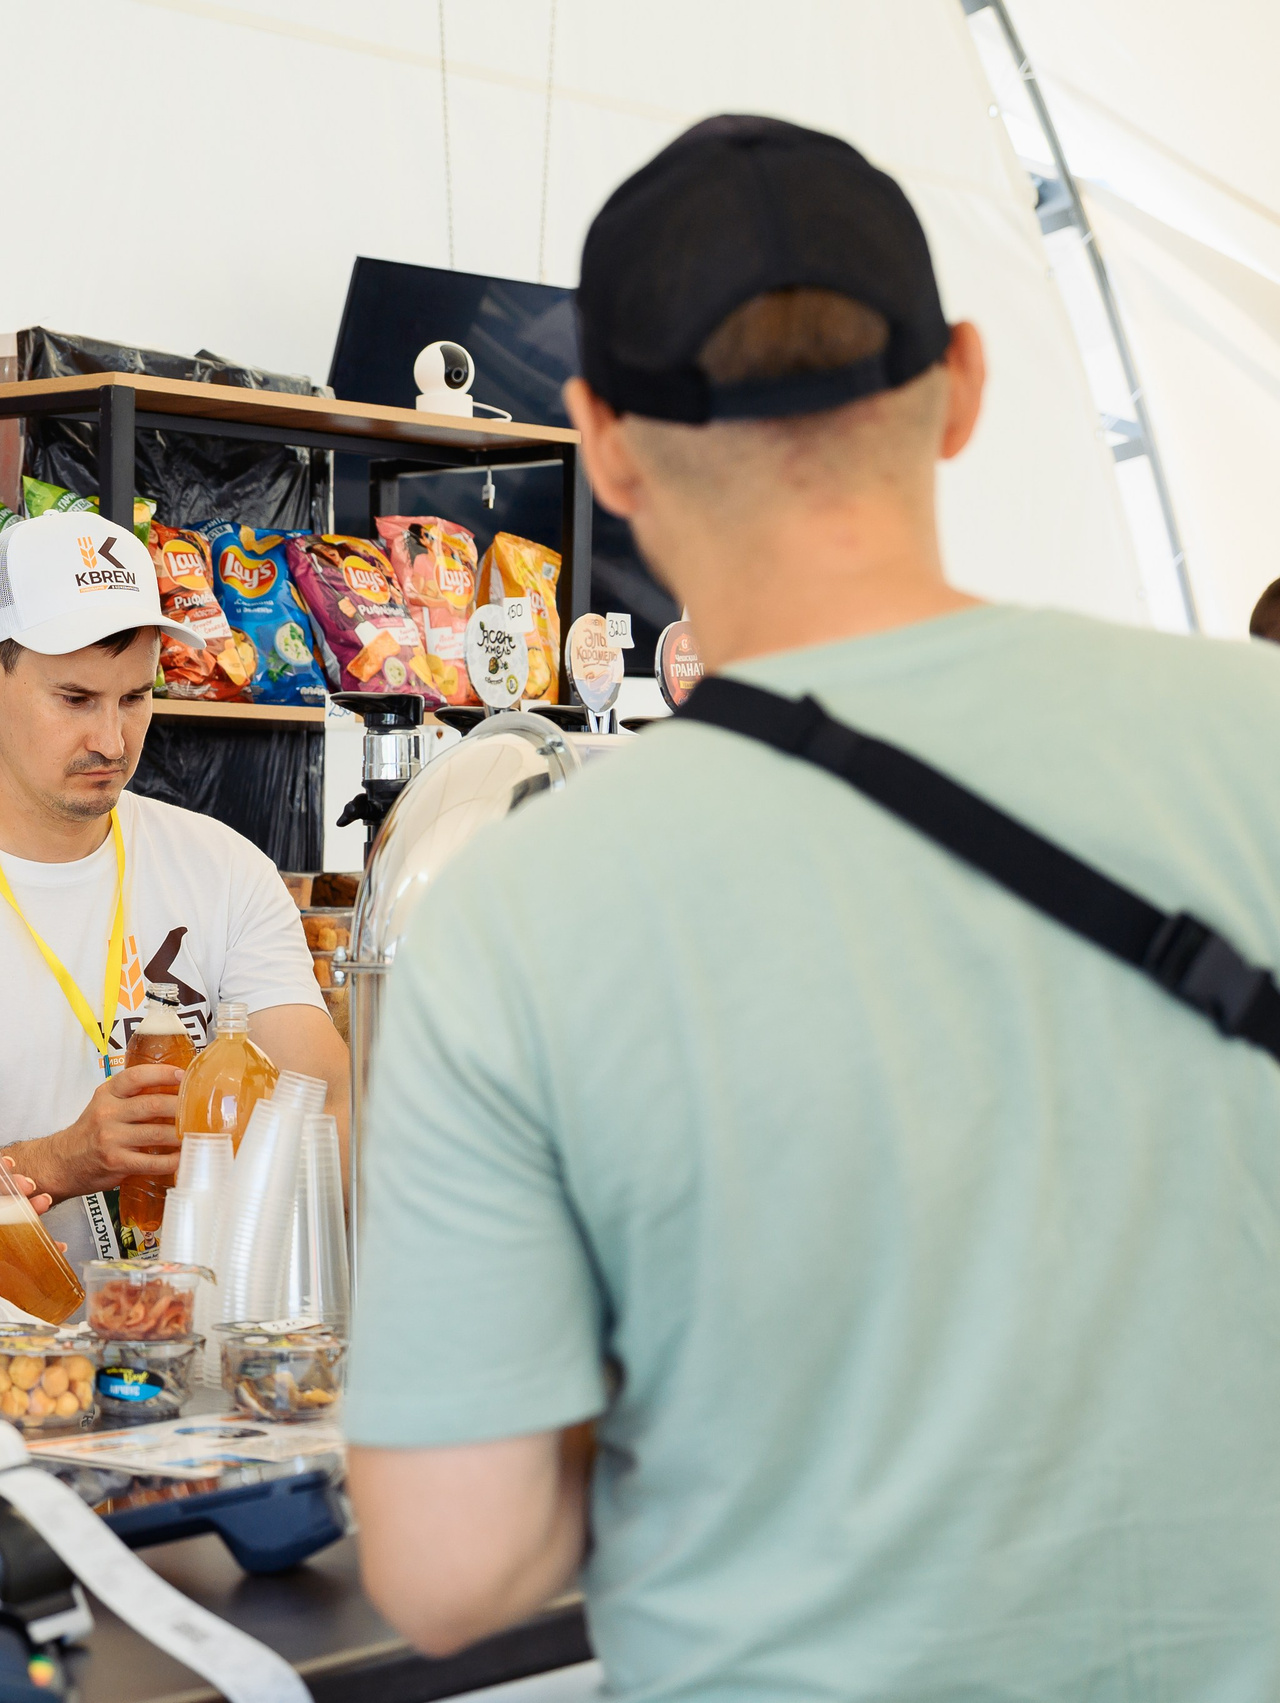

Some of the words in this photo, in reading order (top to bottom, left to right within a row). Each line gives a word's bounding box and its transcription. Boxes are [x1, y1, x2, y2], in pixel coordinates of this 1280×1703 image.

[75, 570, 136, 587] KBREW
[224, 553, 273, 590] Lay's
[347, 566, 384, 593] Lay's
[439, 564, 471, 596] Lay's
[670, 662, 706, 678] ГРАНАТ
